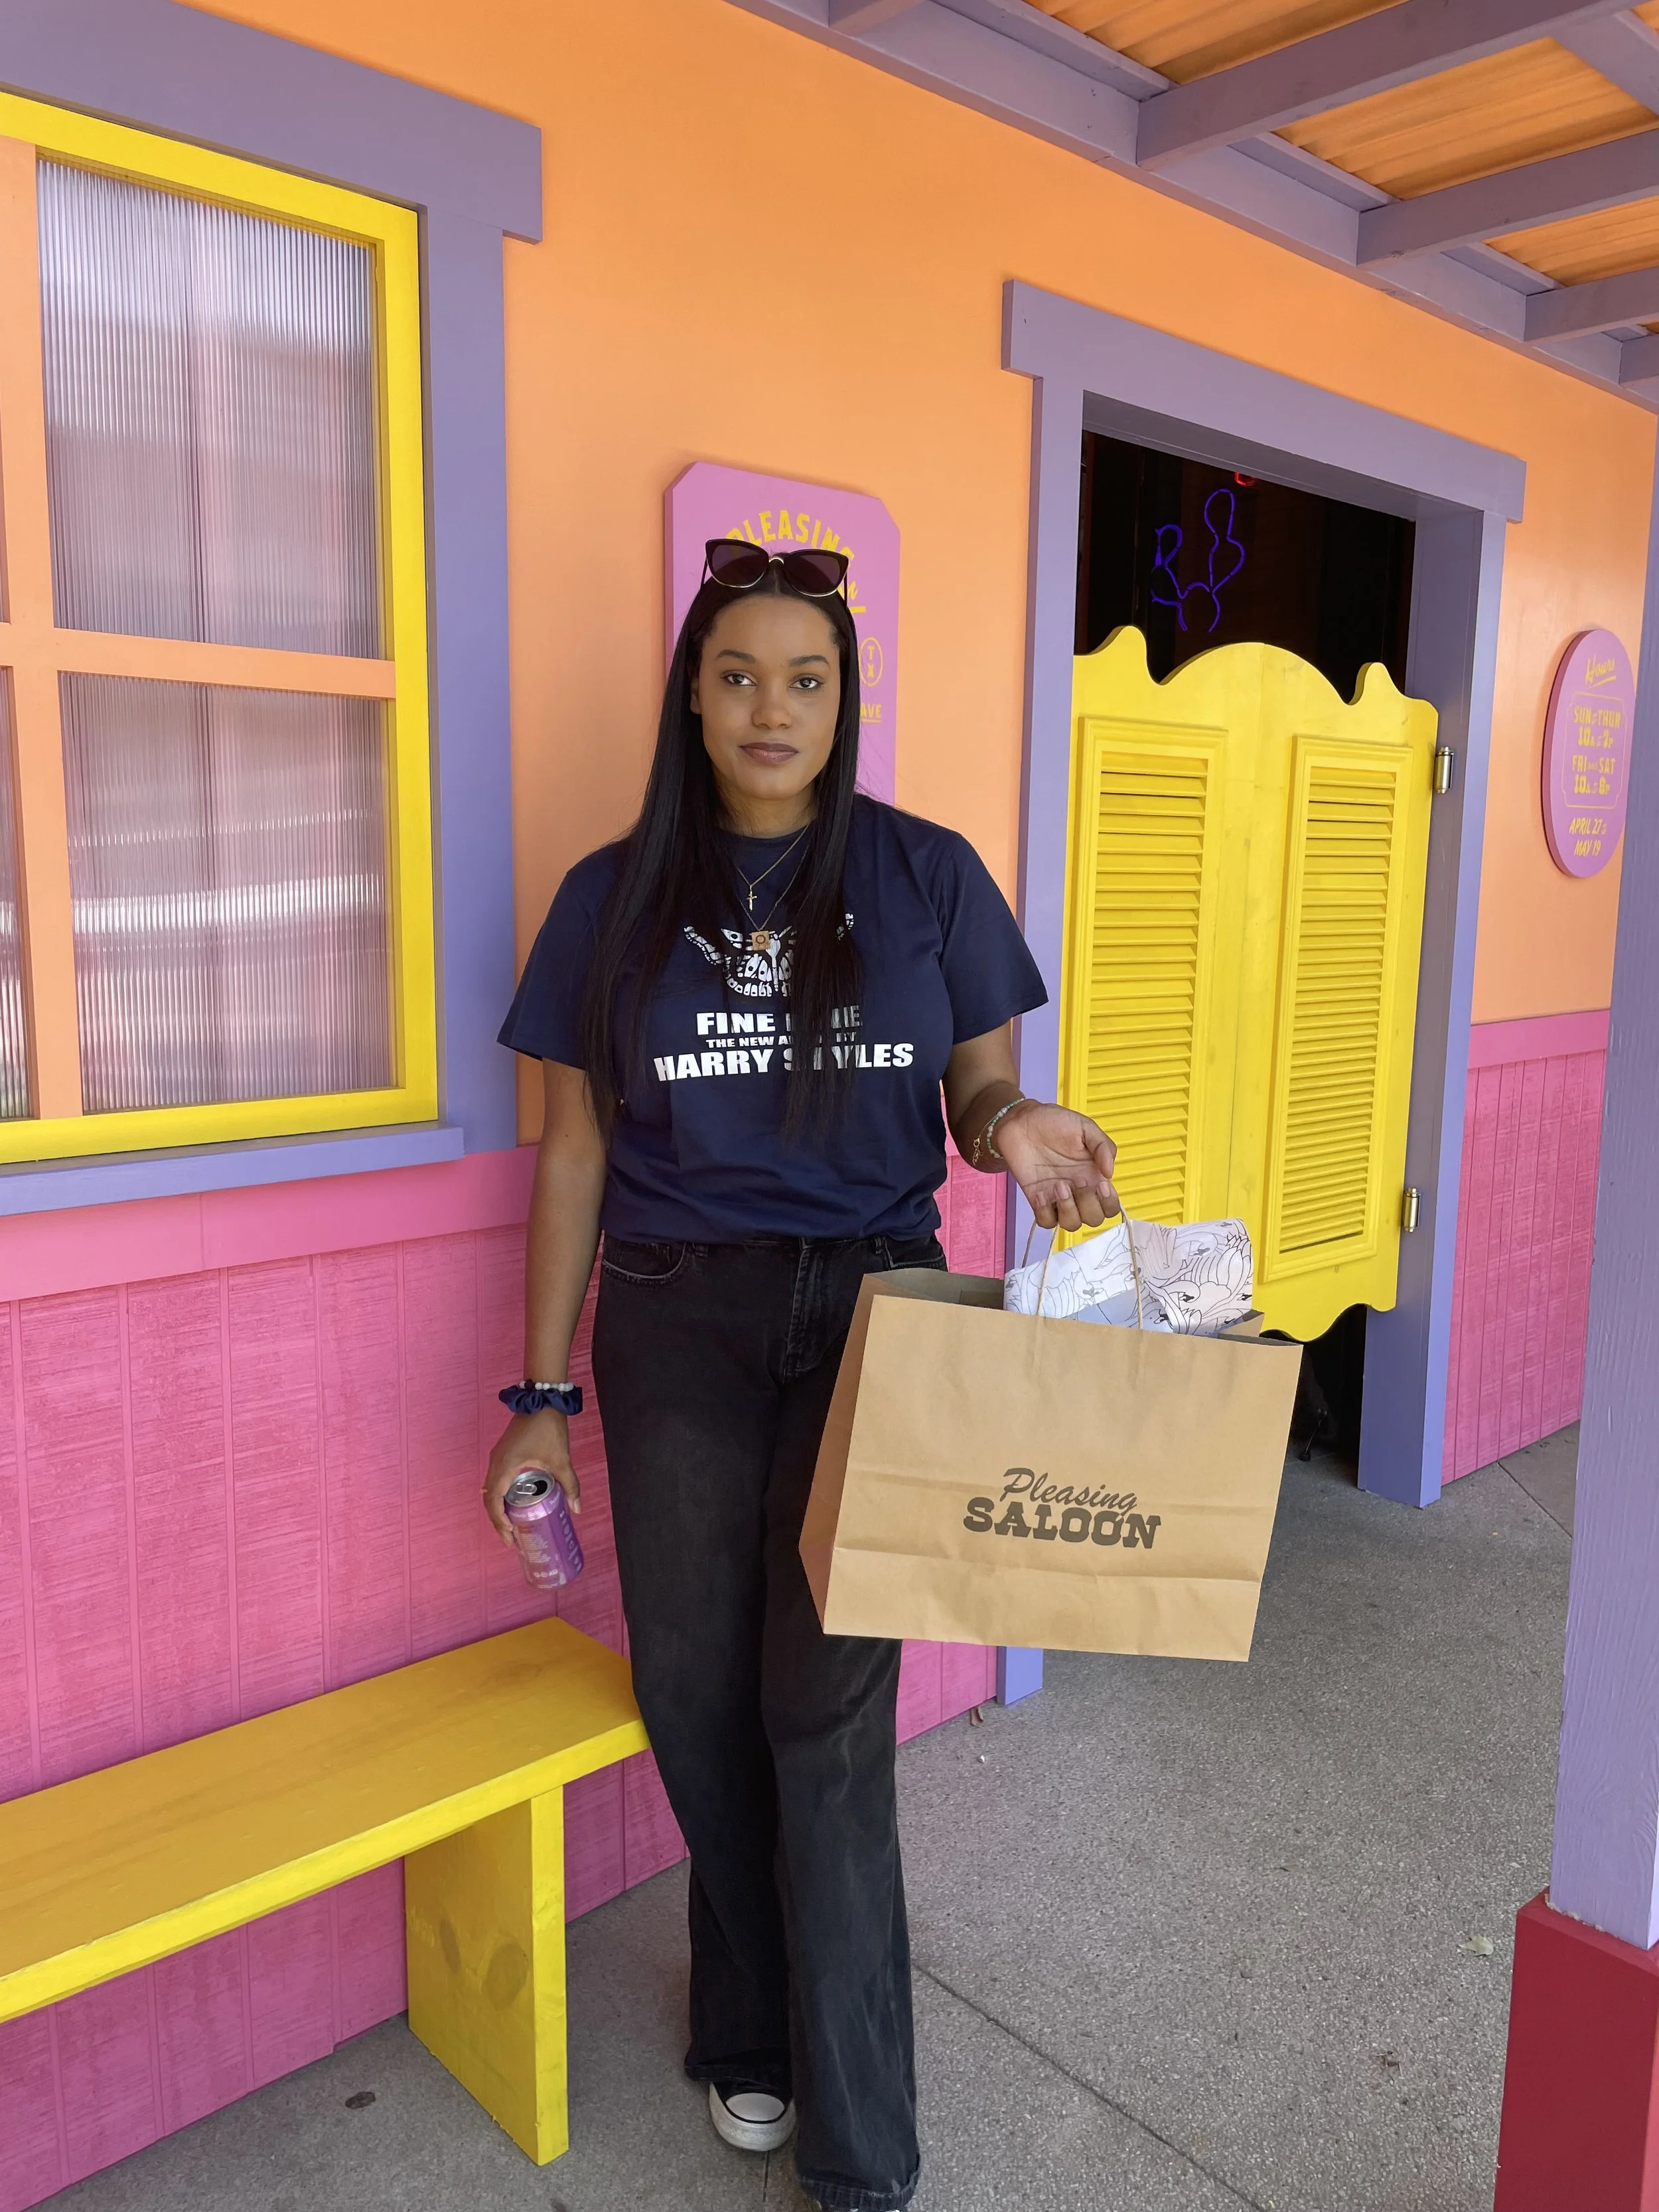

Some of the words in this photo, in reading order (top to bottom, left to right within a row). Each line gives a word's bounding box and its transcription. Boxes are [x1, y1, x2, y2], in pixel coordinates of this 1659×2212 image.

[1574, 705, 1592, 725] SUN
[1598, 709, 1621, 729] THUR
[1572, 755, 1587, 772] FRI
[1599, 757, 1616, 774] SAT
[1569, 818, 1591, 834] APRIL
[1573, 840, 1593, 857] MAY
[696, 1012, 776, 1035] FINE
[705, 1039, 736, 1049] THE
[739, 1037, 775, 1047] NEW
[654, 1049, 774, 1082] HARRY
[999, 1467, 1137, 1521] Pleasing
[963, 1497, 1162, 1549] SALOON
